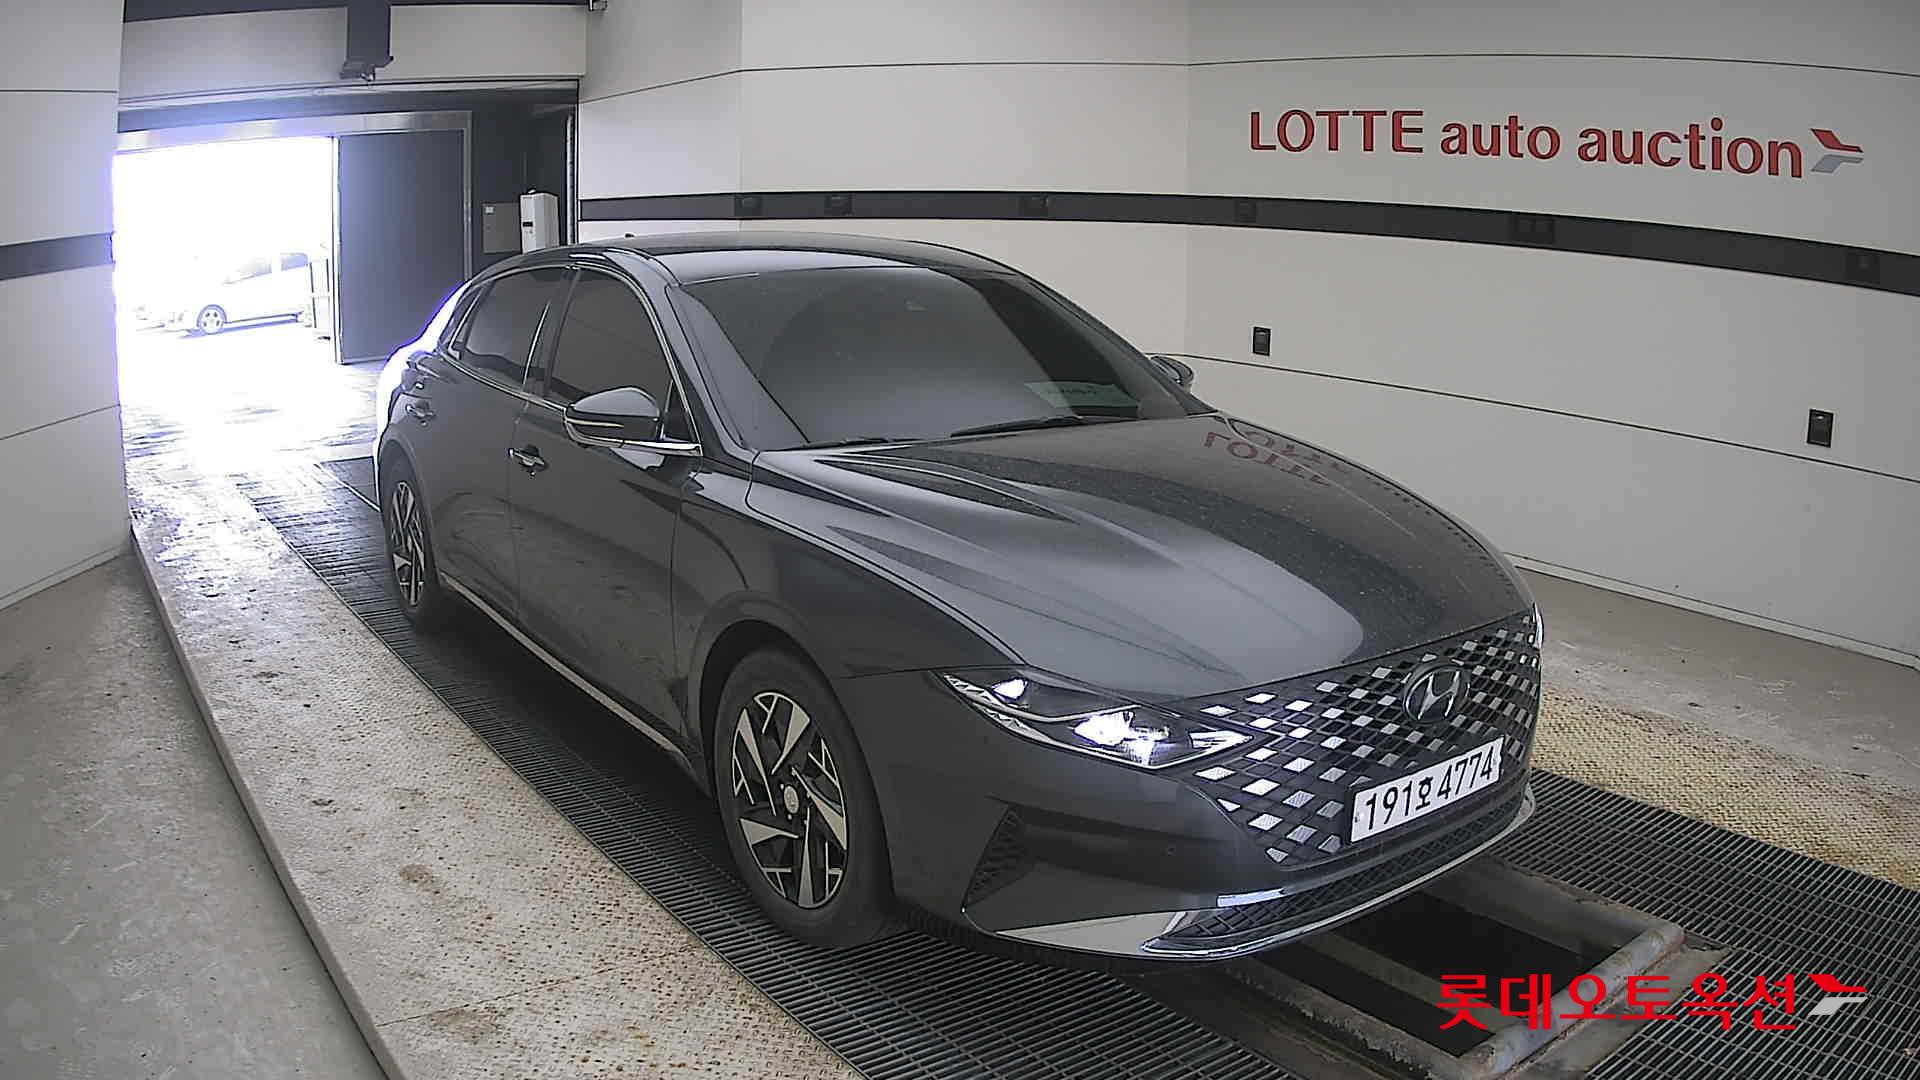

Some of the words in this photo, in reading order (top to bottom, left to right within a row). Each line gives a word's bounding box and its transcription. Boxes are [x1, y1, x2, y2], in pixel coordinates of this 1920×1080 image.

[1250, 111, 1424, 153] LOTTE
[1442, 115, 1562, 159] auto
[1577, 118, 1804, 177] auction
